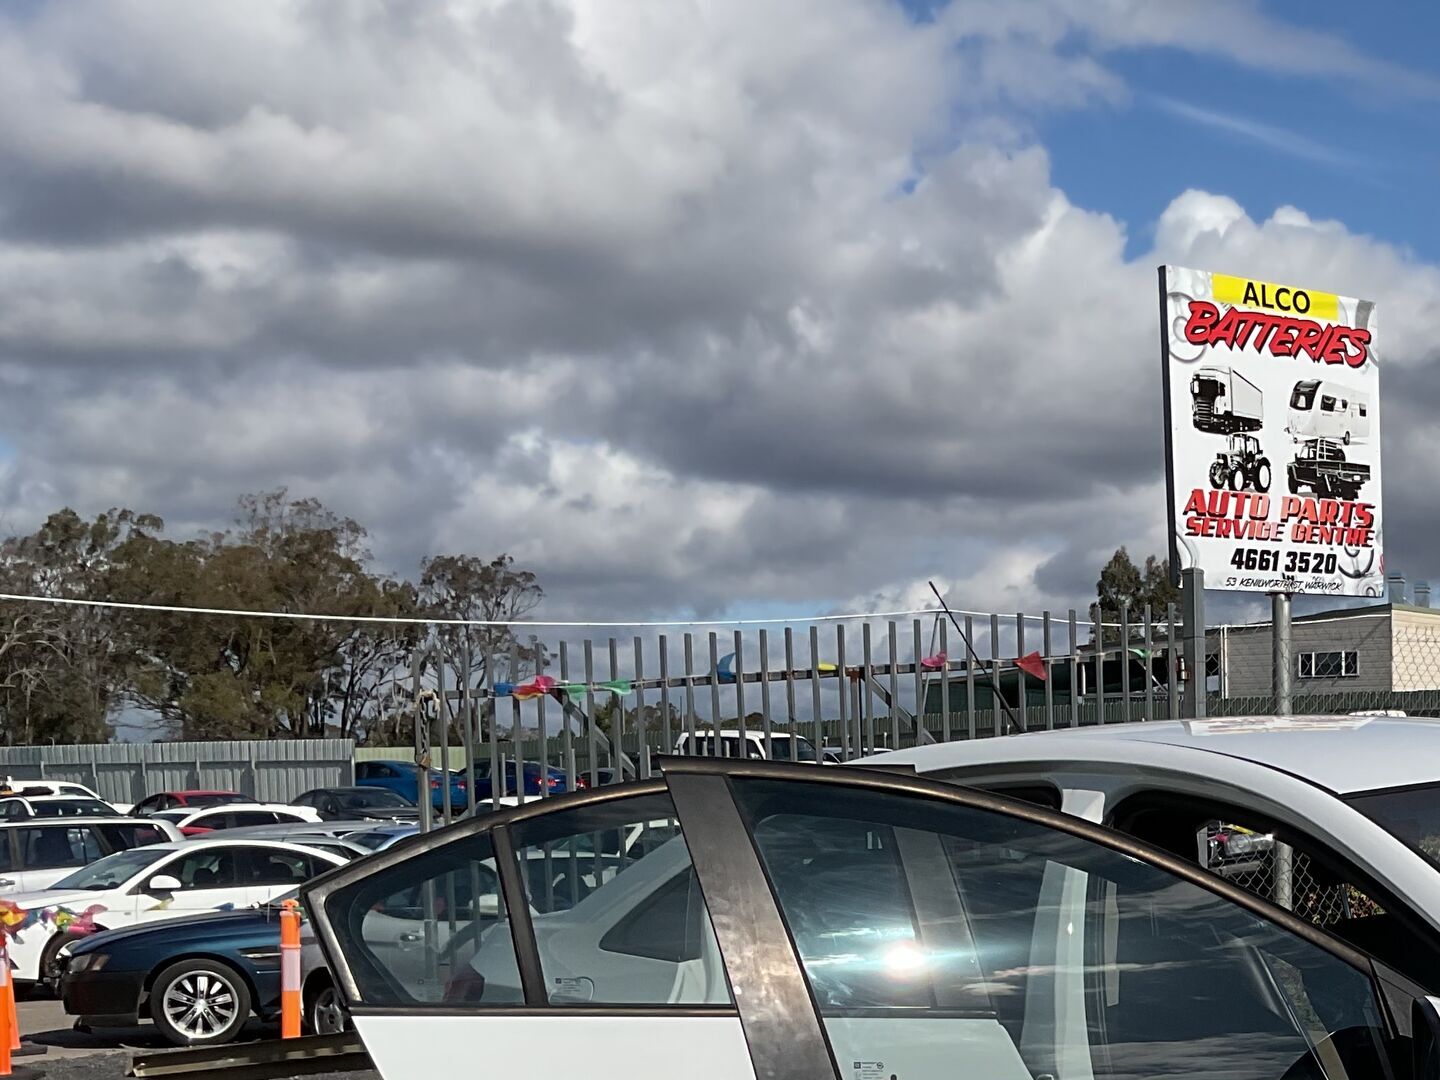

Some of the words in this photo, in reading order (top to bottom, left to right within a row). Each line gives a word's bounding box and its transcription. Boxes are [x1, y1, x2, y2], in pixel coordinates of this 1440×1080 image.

[1243, 282, 1310, 314] ALCO
[1184, 301, 1371, 368] BATTERIES
[1183, 489, 1271, 520] AUTO
[1281, 495, 1375, 528] PARTS
[1185, 516, 1283, 542] SERVICE
[1291, 520, 1374, 547] CENTRE
[1230, 548, 1279, 572] 4661
[1284, 552, 1337, 574] 3520
[1226, 578, 1237, 587] 53
[1305, 581, 1342, 591] WARWICK
